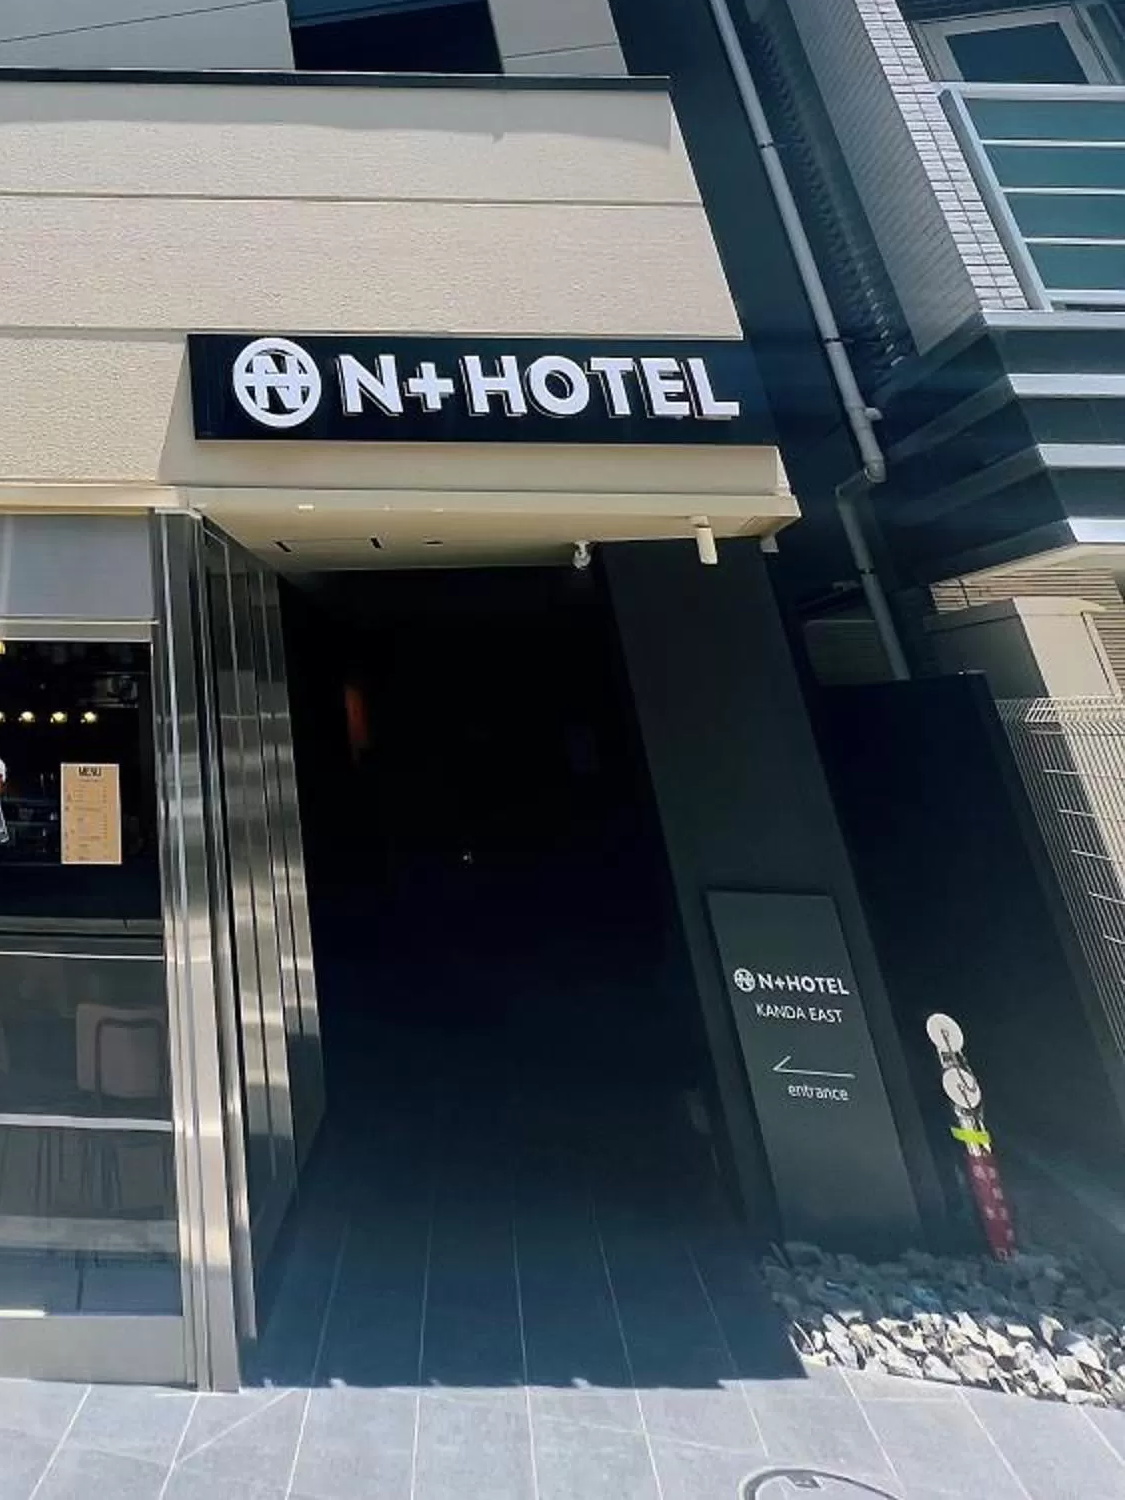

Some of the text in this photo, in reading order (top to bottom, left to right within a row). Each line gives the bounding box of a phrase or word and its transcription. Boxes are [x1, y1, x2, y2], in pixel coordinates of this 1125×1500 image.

[336, 354, 740, 421] N+HOTEL
[758, 973, 850, 995] N+HOTEL
[755, 1003, 843, 1023] KANDA EAST
[788, 1083, 849, 1101] entrance
